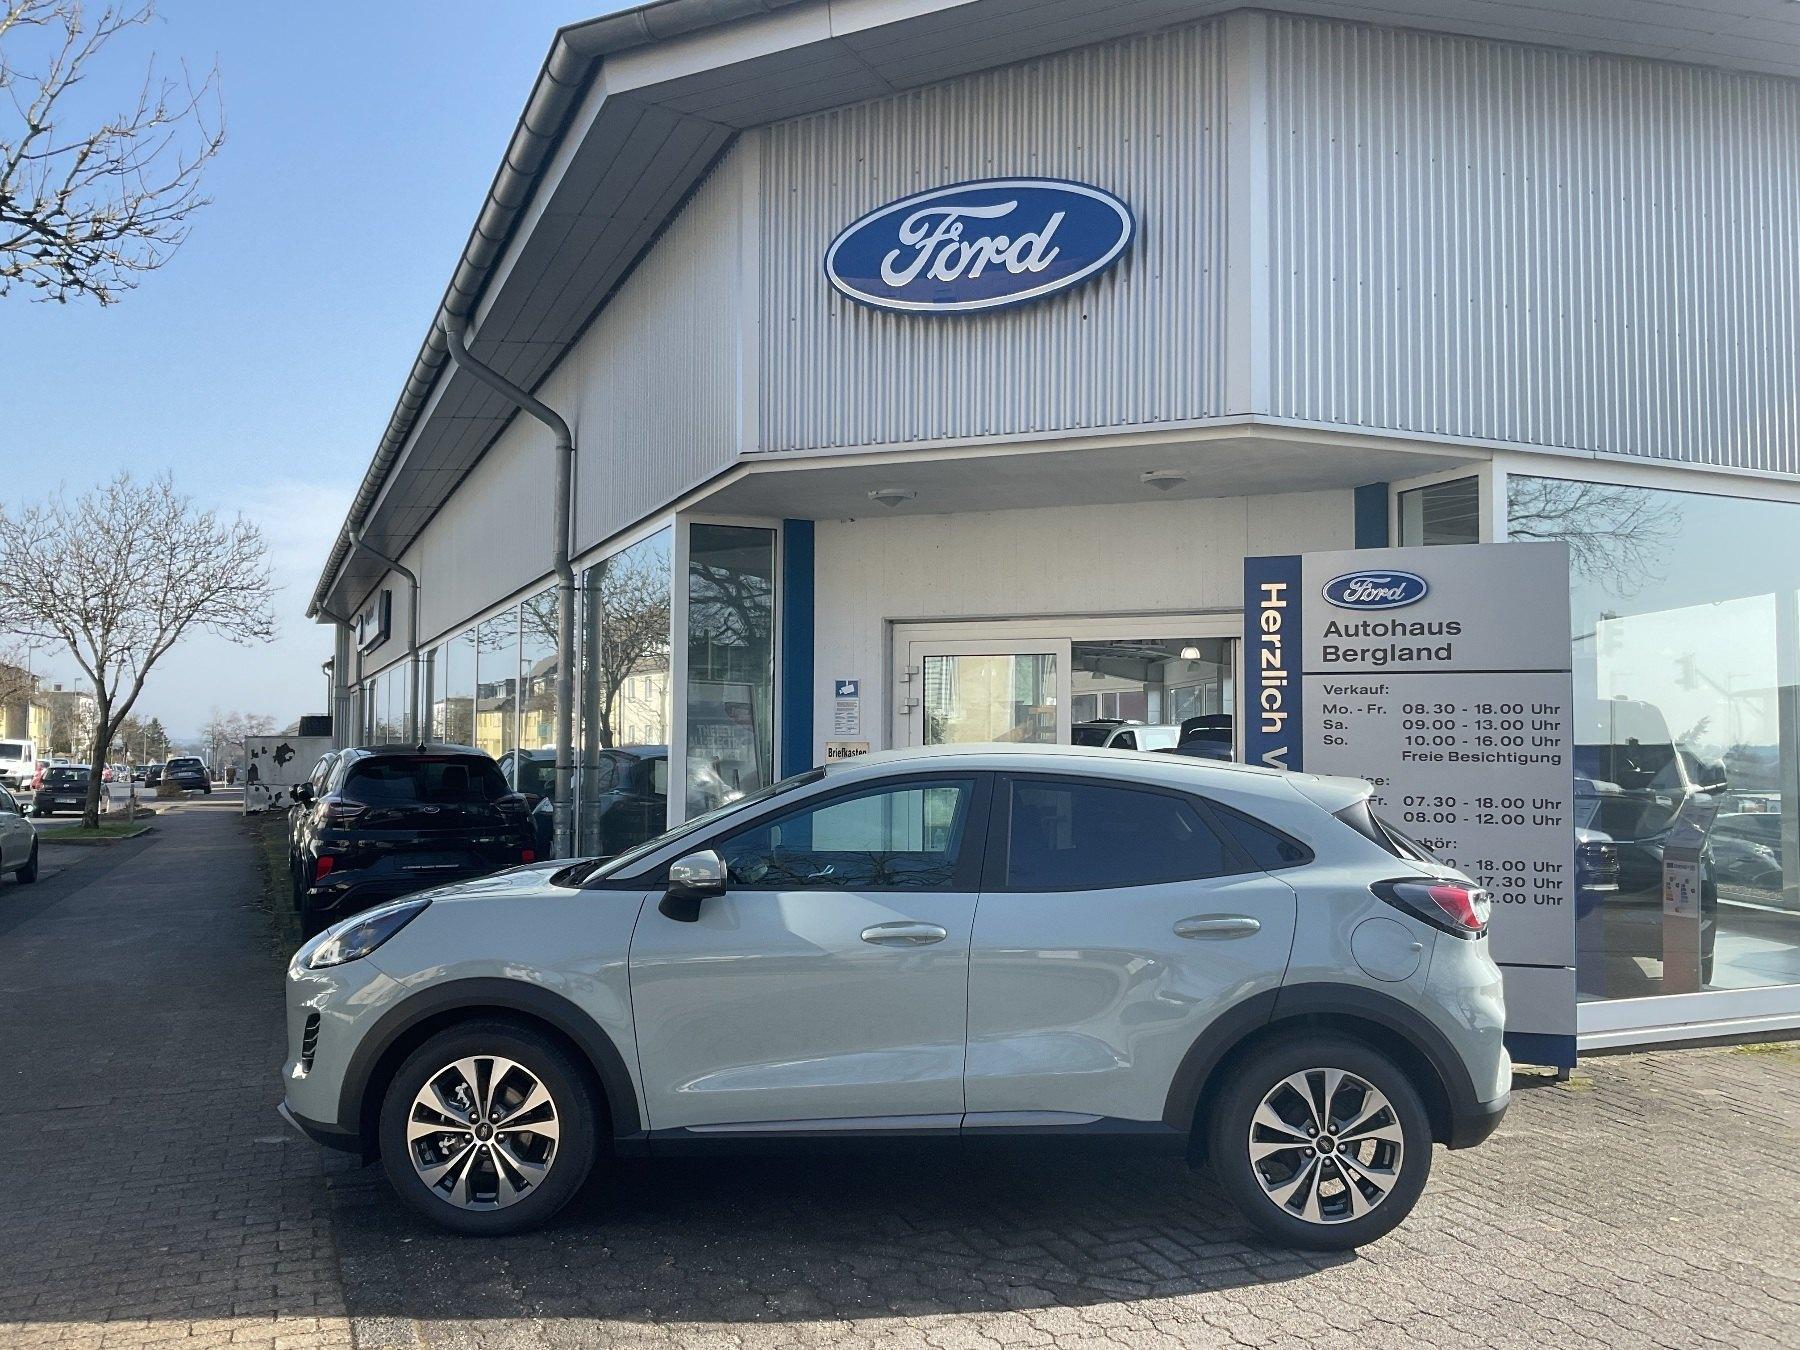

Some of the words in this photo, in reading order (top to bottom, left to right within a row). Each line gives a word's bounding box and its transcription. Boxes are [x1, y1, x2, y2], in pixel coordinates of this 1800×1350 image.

[881, 200, 1066, 287] Ford
[1343, 577, 1406, 602] Ford
[1323, 619, 1462, 638] Autohaus
[1260, 583, 1288, 733] Herzlich
[1322, 643, 1452, 666] Bergland
[1323, 684, 1389, 695] Verkauf:
[1322, 704, 1353, 714] Mo.
[1367, 704, 1387, 714] Fr.
[1402, 704, 1455, 714] 08.30
[1474, 704, 1523, 714] 18.00
[1531, 704, 1560, 714] Uhr
[1323, 719, 1348, 730] Sa.
[1402, 719, 1455, 730] 09.00
[1474, 720, 1524, 730] 13.00
[1531, 720, 1560, 730] Uhr
[1323, 734, 1348, 745] So.
[1405, 735, 1456, 746] 10.00
[1474, 736, 1524, 746] 16.00
[1531, 736, 1560, 747] Uhr
[1402, 751, 1443, 762] Freie
[1448, 751, 1561, 765] Besichtigung
[1403, 795, 1456, 807] 07.30
[1475, 798, 1525, 809] 18.00
[1532, 799, 1561, 809] Uhr
[1403, 812, 1456, 823] 08.00
[1475, 814, 1525, 825] 12.00
[1532, 815, 1562, 826] Uhr
[1476, 860, 1526, 871] 18.00
[1533, 862, 1562, 872] Uhr
[1476, 876, 1526, 888] 17.30
[1533, 878, 1563, 889] Uhr
[1487, 893, 1526, 904] 2.00
[1533, 894, 1563, 905] Uhr
